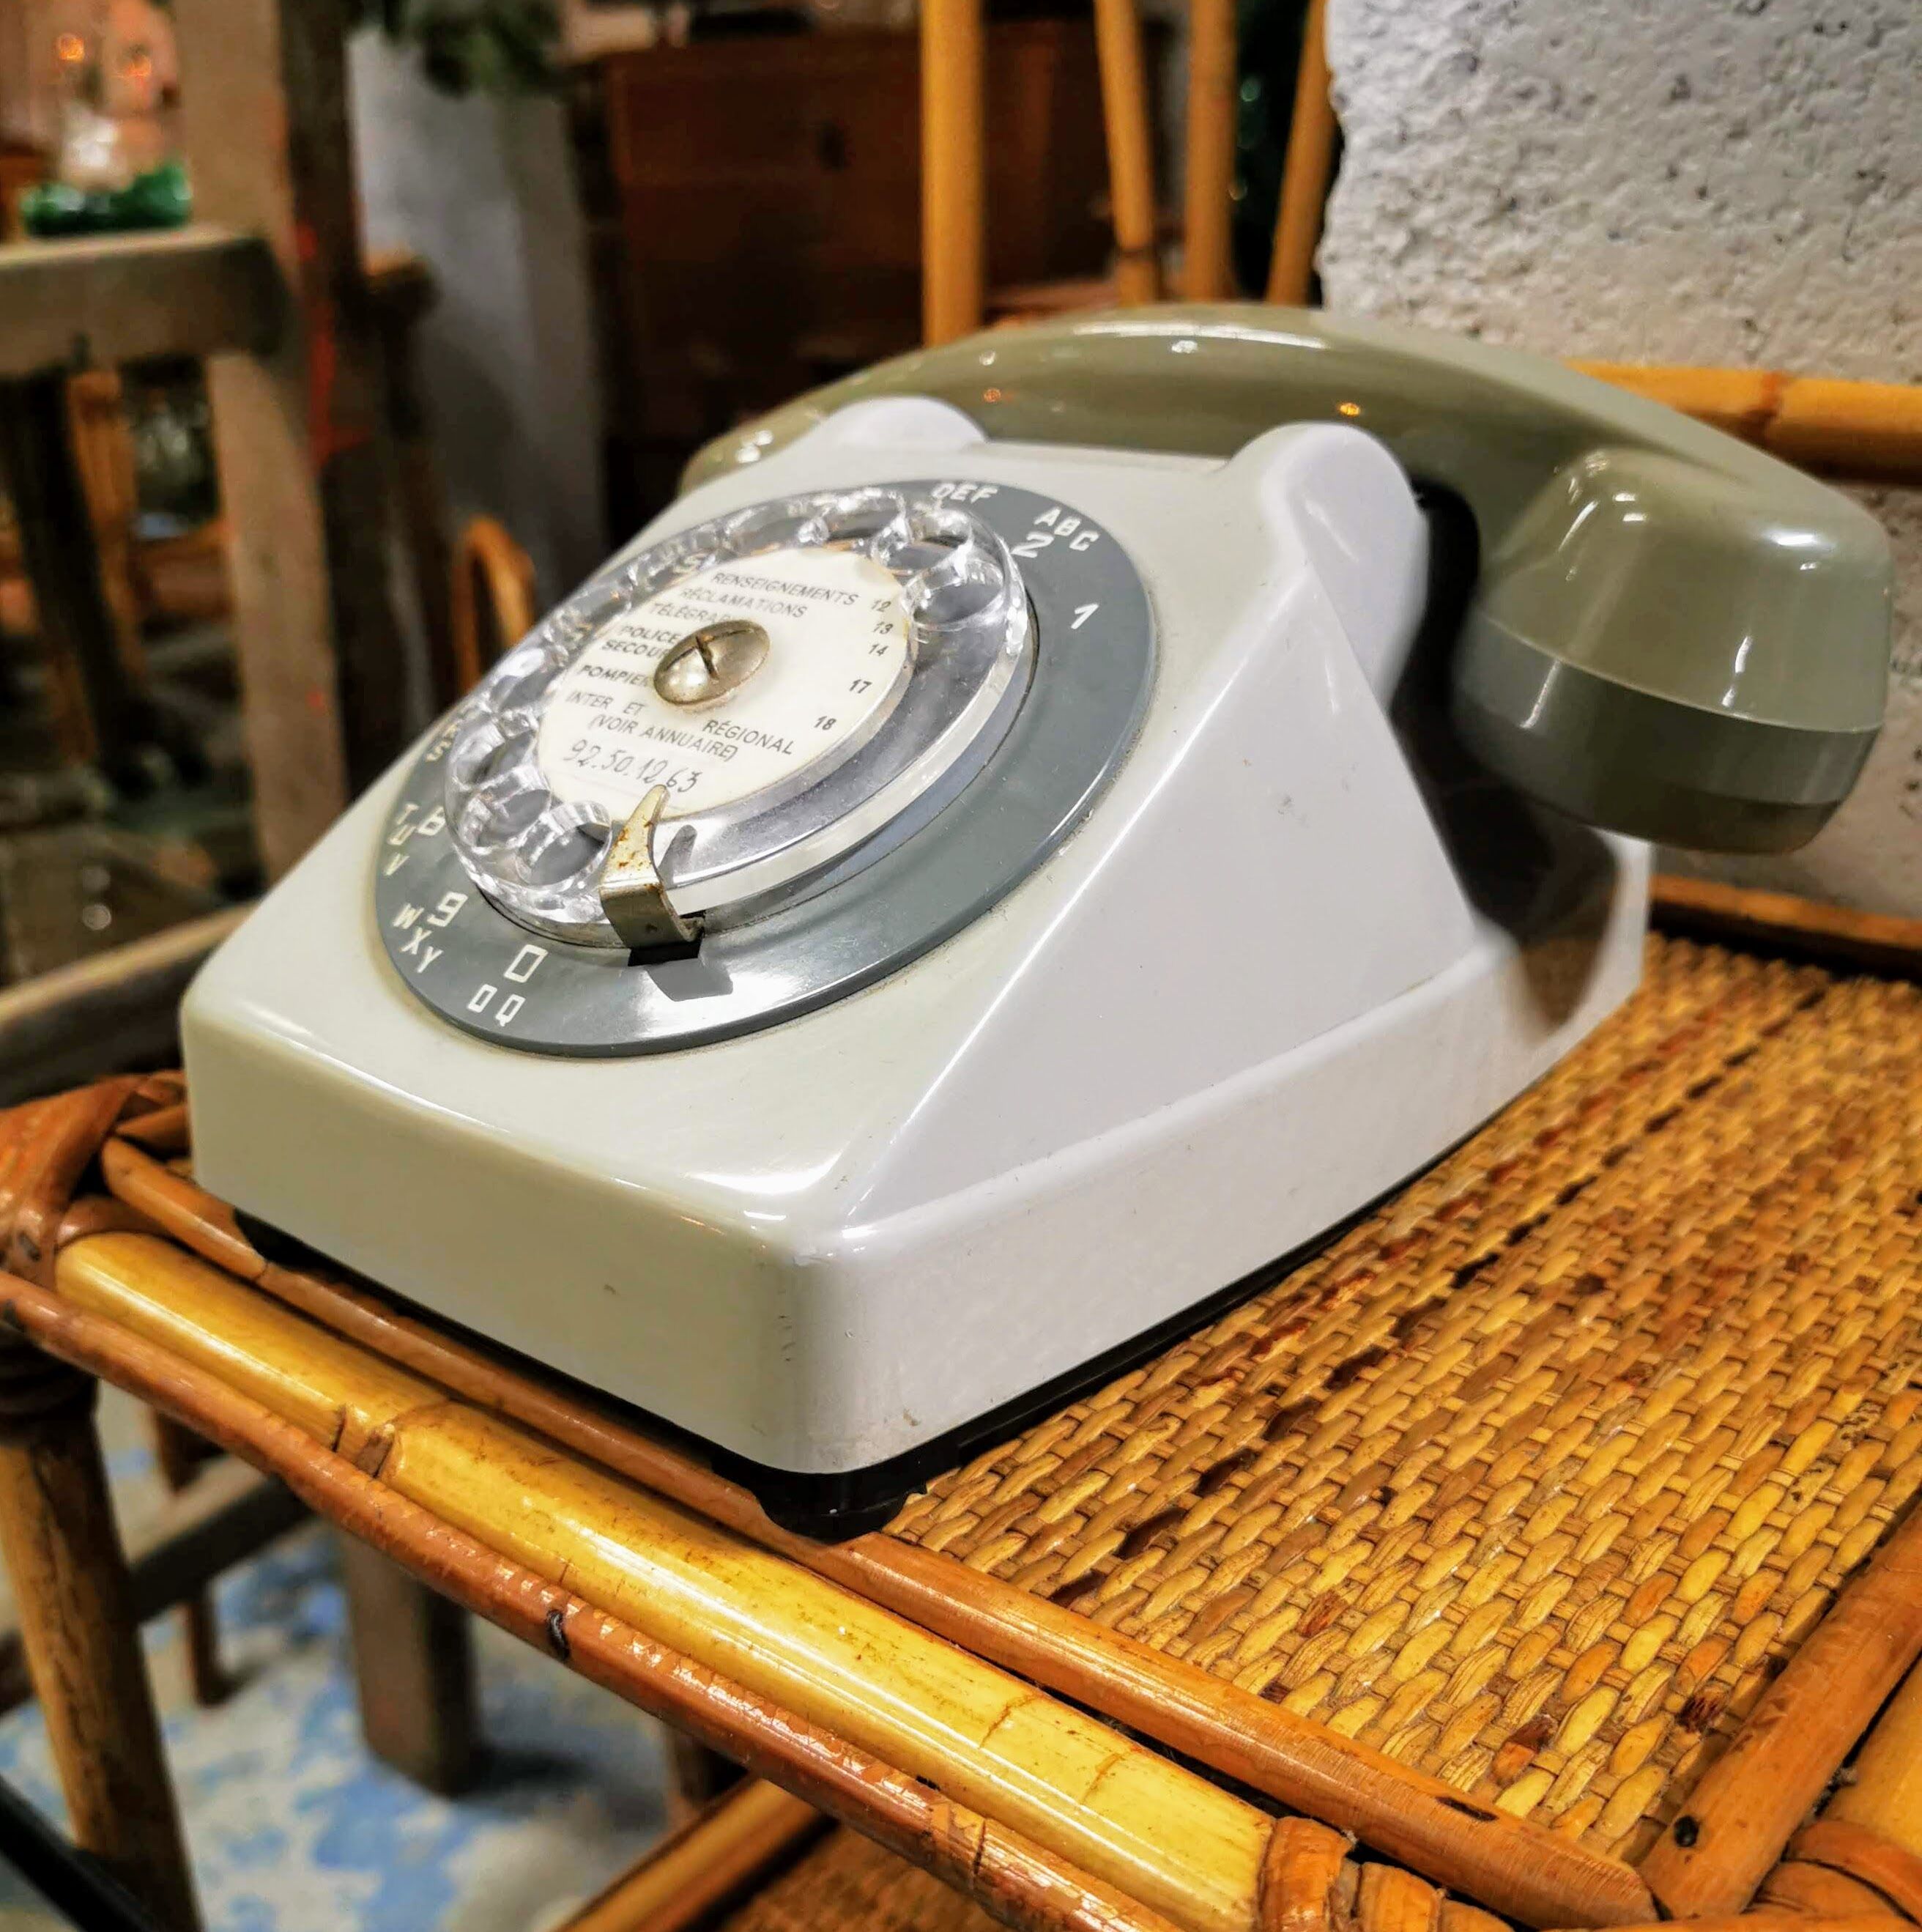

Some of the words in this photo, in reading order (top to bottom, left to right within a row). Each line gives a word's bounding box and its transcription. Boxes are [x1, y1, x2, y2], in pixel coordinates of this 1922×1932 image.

[931, 483, 998, 504] DEF
[1033, 506, 1099, 552] ABC
[1011, 531, 1055, 559] 2
[713, 572, 859, 607] RENSEIGNEMENTS
[870, 599, 891, 613] 12
[680, 587, 808, 618] RÉCLAMATIONS
[872, 621, 894, 635] 13
[1070, 603, 1099, 630] 1
[621, 625, 682, 645] POLICE
[868, 643, 889, 656] 14
[850, 678, 872, 695] 17
[565, 691, 614, 710] INTER
[622, 701, 645, 717] ET
[702, 718, 796, 755] RÉGIONAL
[814, 715, 837, 730] 18
[587, 714, 639, 735] (VOIR
[642, 725, 739, 762] ANNUAIRE)
[416, 806, 446, 836] 8
[426, 890, 469, 927] 9
[392, 902, 444, 974] WXY
